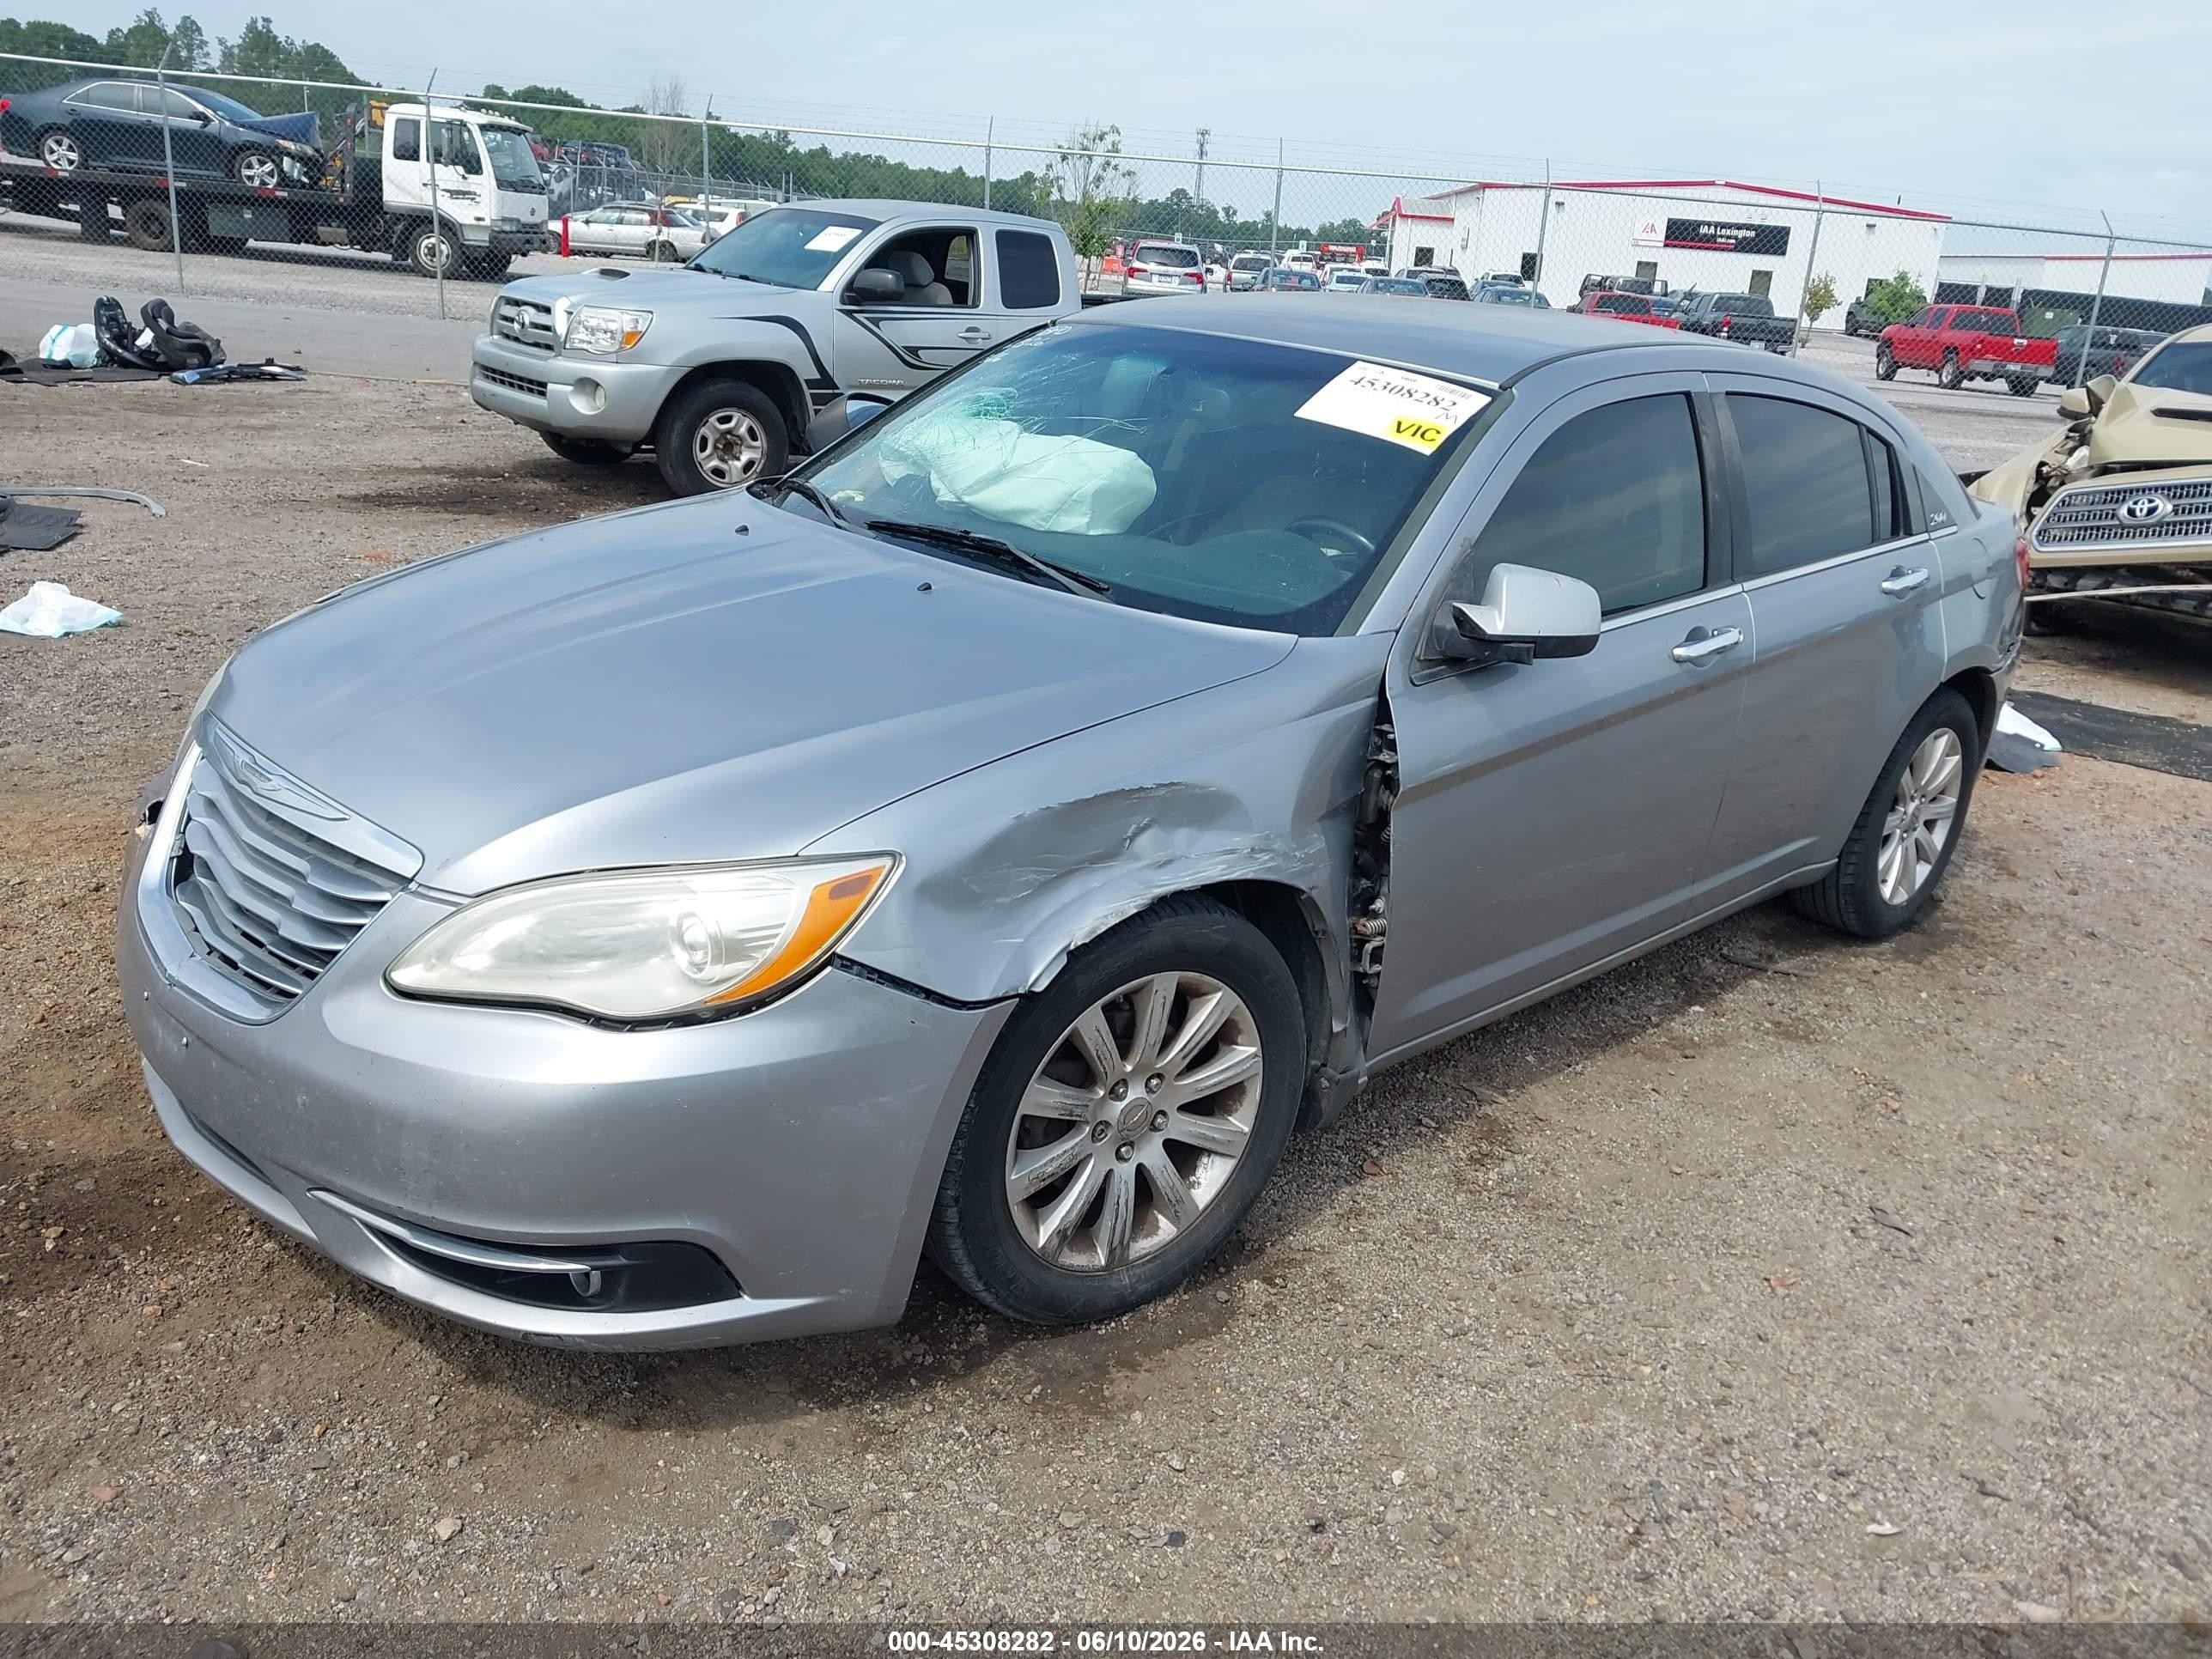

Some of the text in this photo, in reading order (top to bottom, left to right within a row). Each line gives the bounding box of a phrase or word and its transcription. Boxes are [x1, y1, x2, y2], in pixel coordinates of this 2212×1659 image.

[1699, 224, 1756, 239] IAA Lexington
[857, 378, 904, 386] TACOMA
[1350, 375, 1458, 412] 45308282
[1395, 420, 1442, 442] VIC
